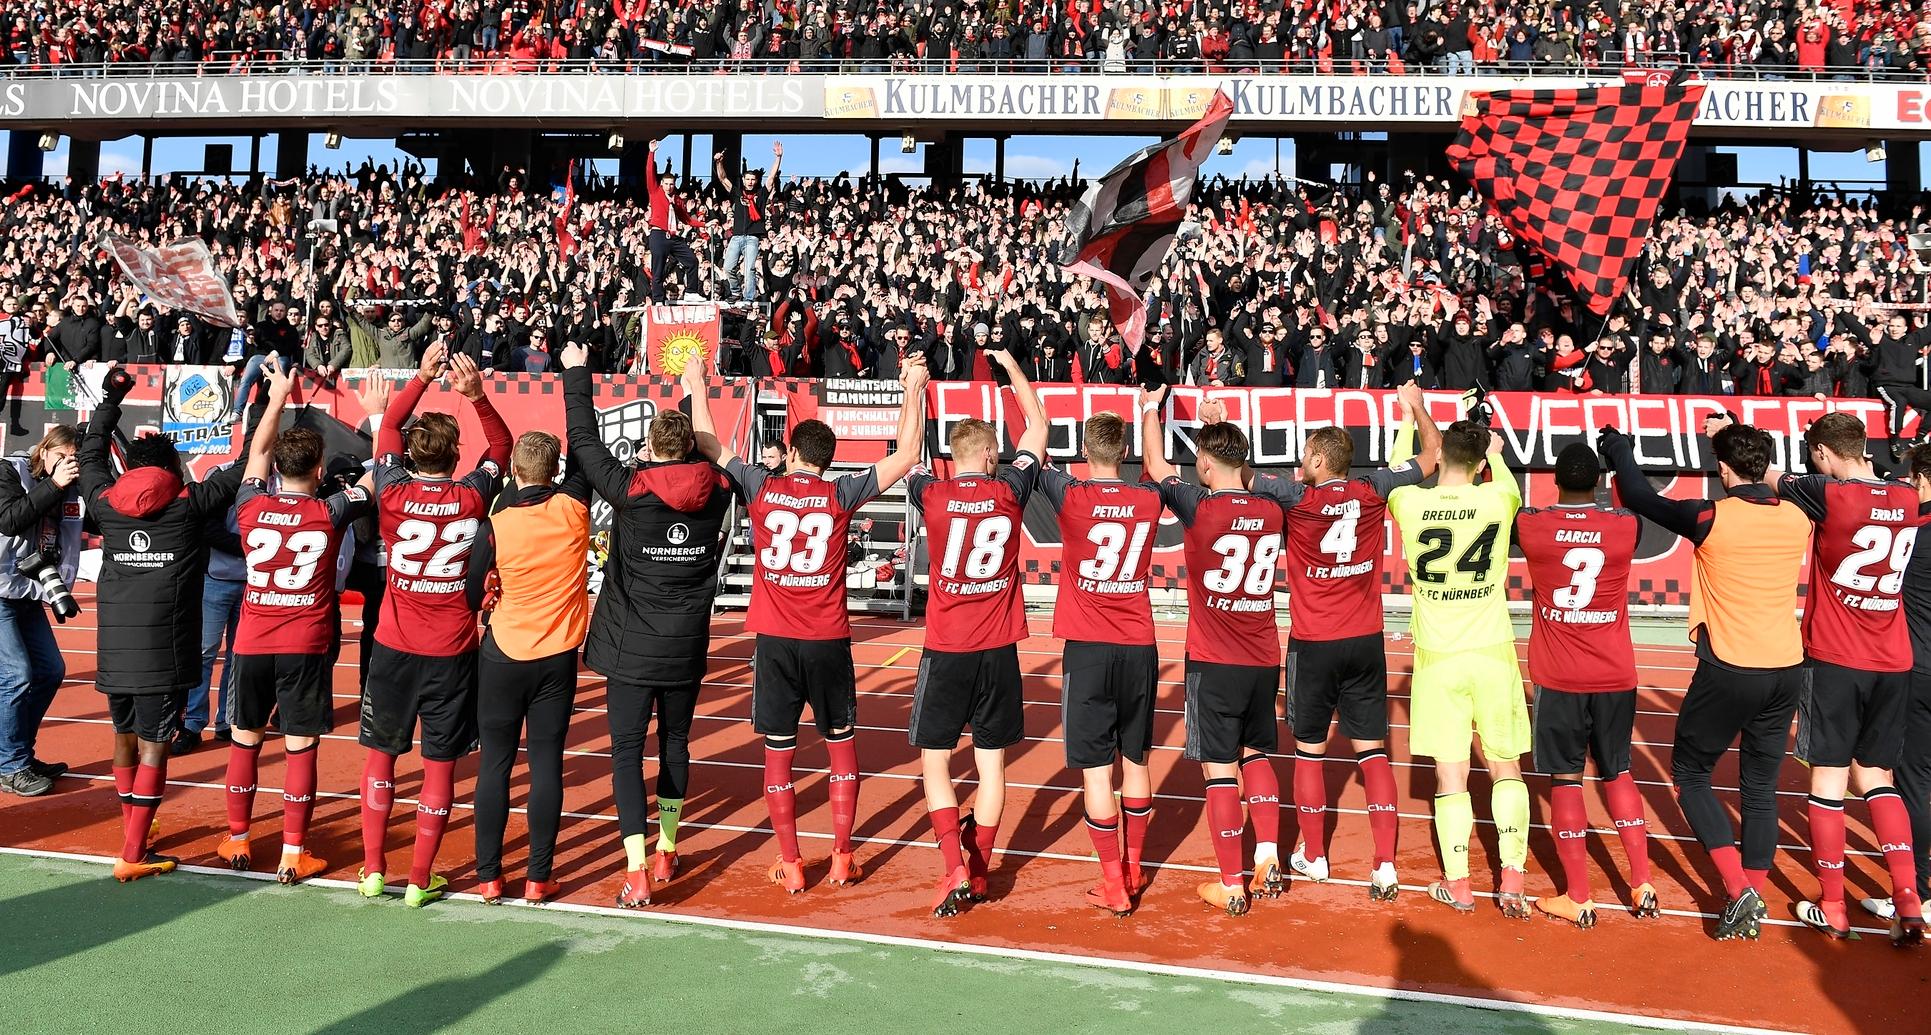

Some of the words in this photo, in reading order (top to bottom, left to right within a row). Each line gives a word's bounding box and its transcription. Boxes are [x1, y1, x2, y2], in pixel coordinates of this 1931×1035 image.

[70, 81, 229, 115] NOVINA
[238, 79, 399, 113] HOTELS
[447, 79, 624, 113] NOVINA
[631, 78, 804, 113] HOTELS
[884, 78, 1101, 115] KULMBACHER
[1231, 79, 1453, 116] KULMBACHER
[825, 99, 874, 117] KULMBACHER
[1110, 98, 1162, 118] KULMBACHER
[403, 501, 460, 516] VALENTINI
[946, 499, 995, 513] BEHRENS
[1092, 505, 1136, 518] PETRAK
[257, 511, 301, 526] LEIBOLD
[1422, 509, 1477, 521] BREDLOW
[1869, 508, 1905, 522] ERRAS
[1231, 517, 1265, 531] LÖWEN
[760, 509, 834, 574] 33
[1320, 514, 1358, 564] 4
[1555, 529, 1602, 544] GARCIA
[390, 517, 479, 578] 22
[641, 545, 707, 556] NÜRNBERGER
[941, 516, 1012, 579] 18
[1079, 521, 1151, 581] 31
[1416, 521, 1502, 584] 24
[246, 527, 328, 590] 23
[1203, 533, 1281, 595] 38
[1830, 524, 1919, 595] 29
[1315, 567, 1329, 578] FC
[1329, 560, 1374, 578] NÜRNBERG
[397, 577, 411, 591] FC
[410, 575, 467, 594] NÜRNBERG
[779, 573, 831, 587] NÜRNBERG
[1083, 579, 1095, 592] FC
[1096, 578, 1145, 593] NÜRNBERG
[1552, 547, 1606, 609] 3
[945, 582, 959, 595] FC
[1427, 590, 1439, 600] FC
[250, 592, 260, 604] FC
[260, 590, 316, 606] NÜRNBERG
[1216, 598, 1230, 611] FC
[1843, 594, 1861, 609] FC
[1549, 609, 1562, 622] FC
[1563, 607, 1618, 623] NÜRNBERG
[829, 773, 856, 783] Club
[766, 782, 794, 793] Club
[283, 793, 311, 802] Club
[1249, 794, 1279, 804] Club
[417, 803, 448, 815] Club
[1367, 804, 1396, 812] Club
[1615, 818, 1645, 828] Club
[1882, 842, 1911, 853] Club
